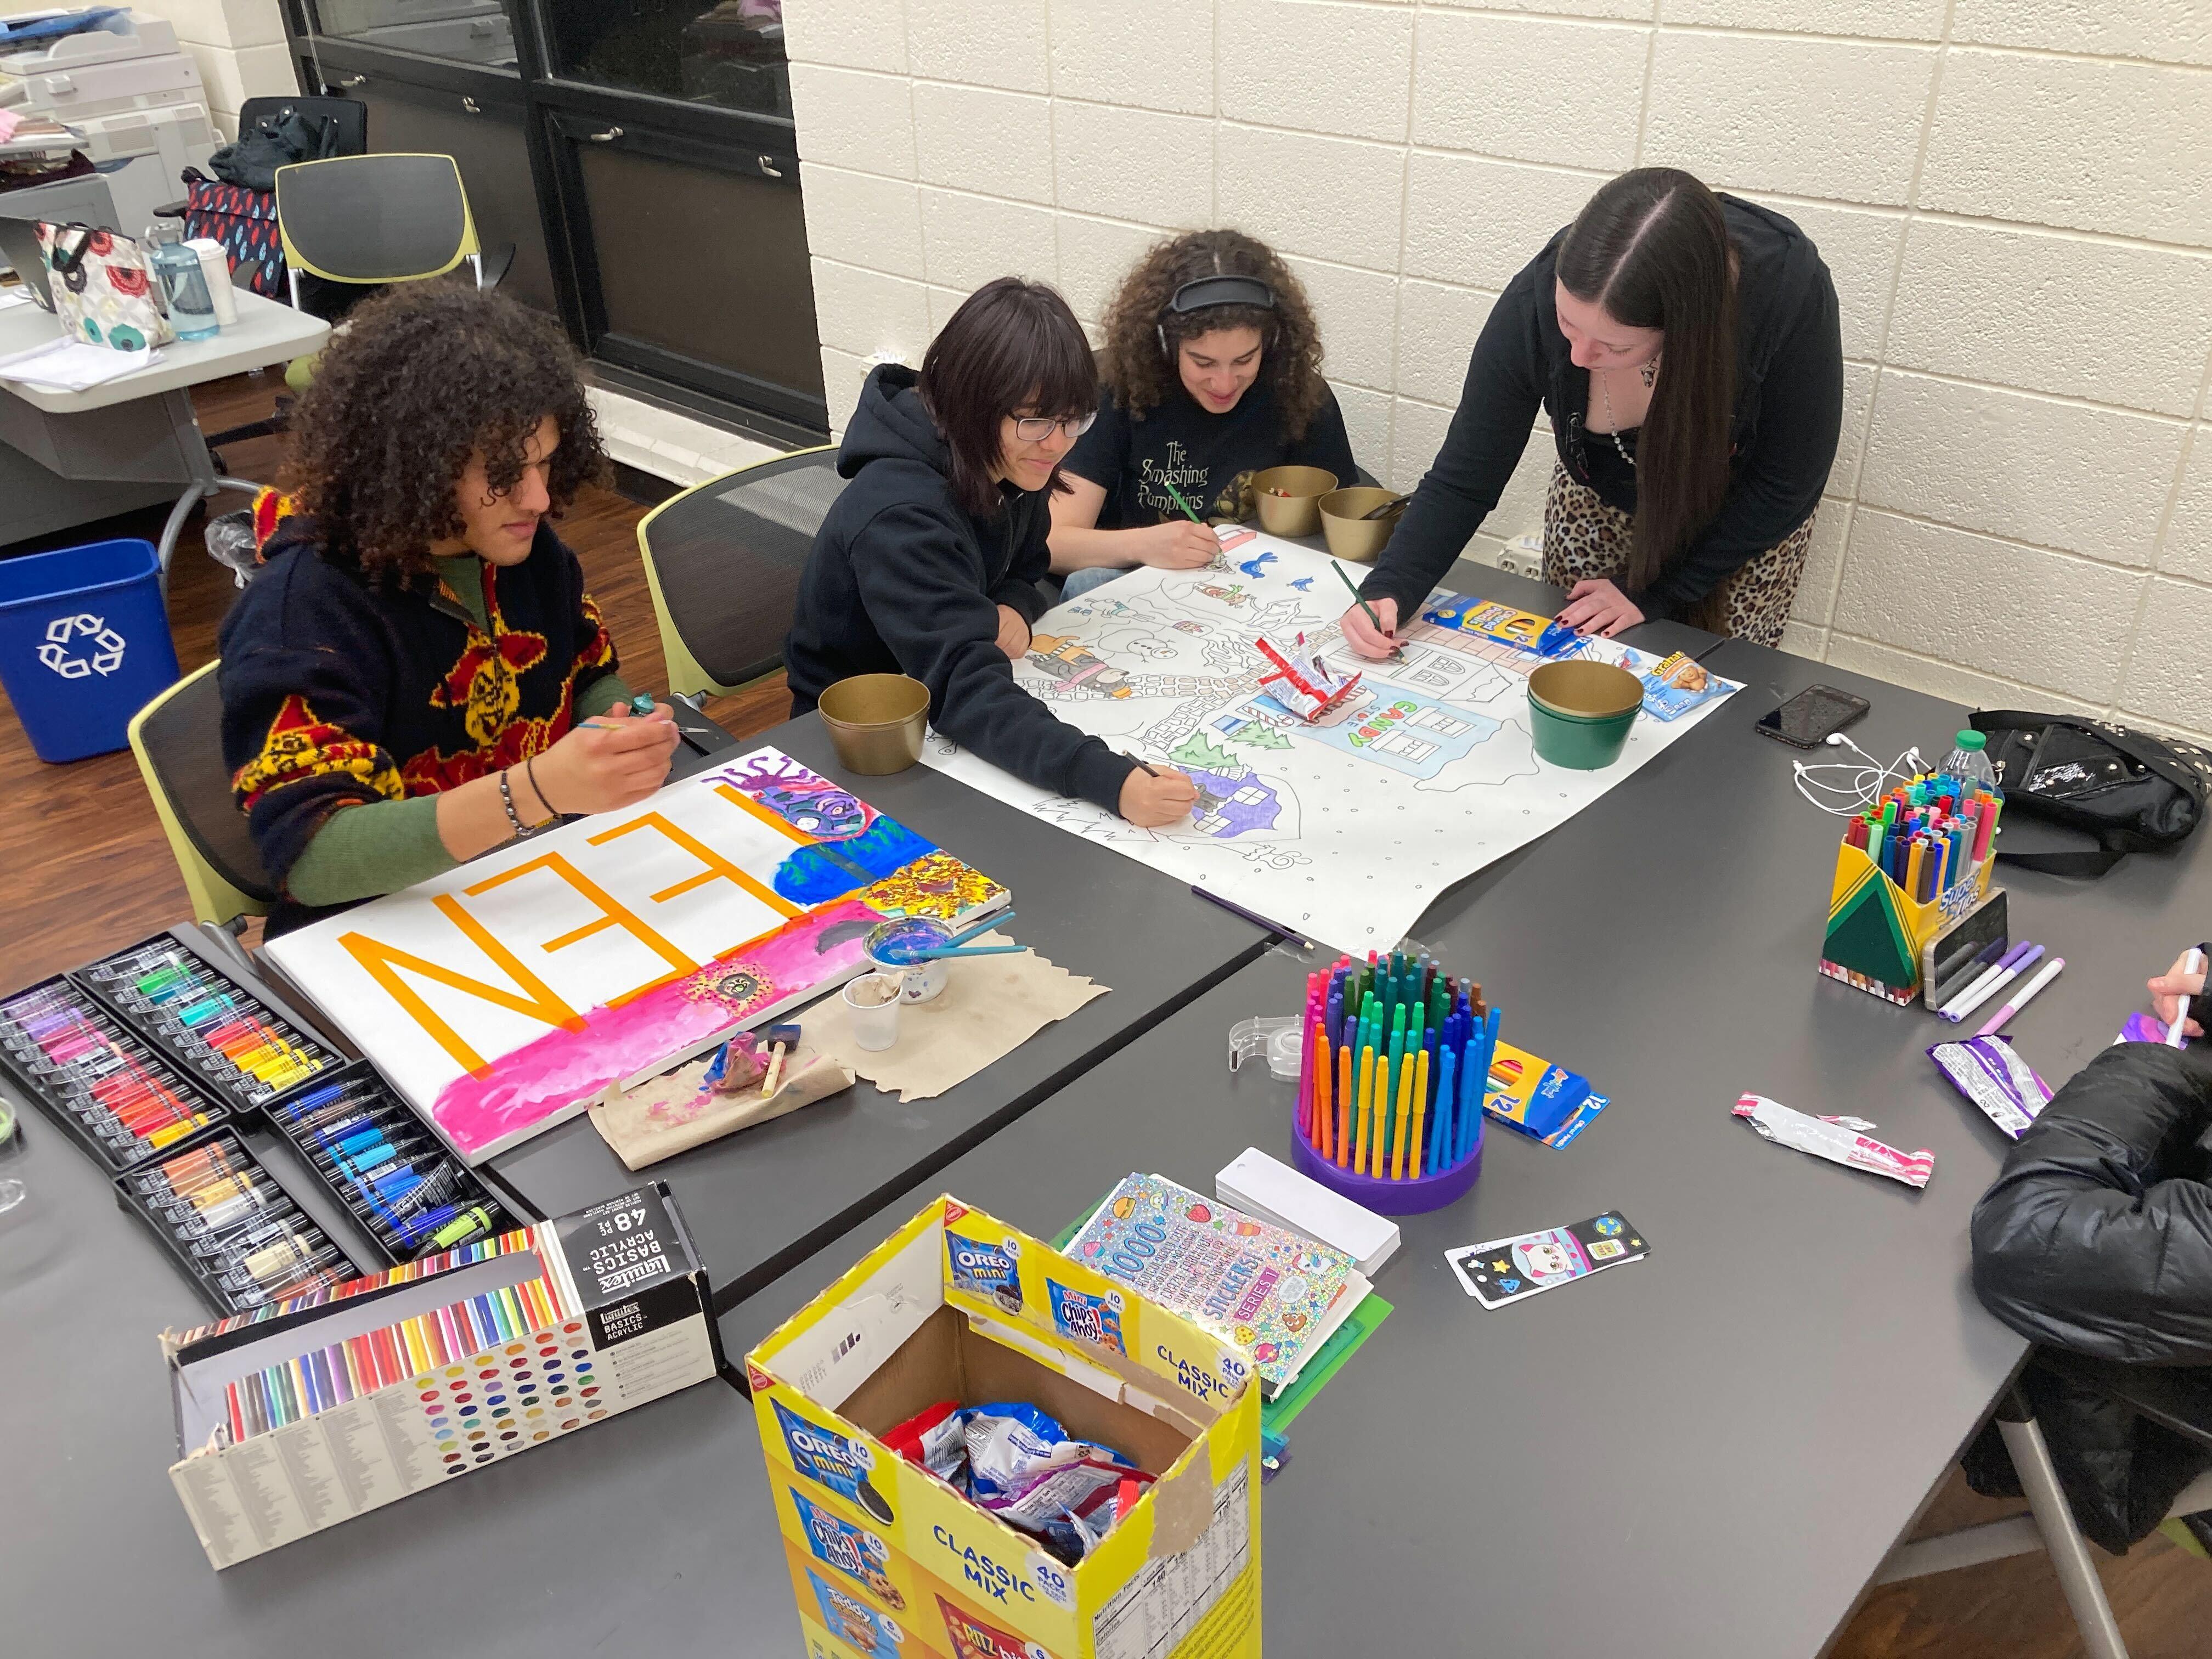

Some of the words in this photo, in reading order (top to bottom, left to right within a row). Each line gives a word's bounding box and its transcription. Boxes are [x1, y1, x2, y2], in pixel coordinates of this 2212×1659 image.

[1166, 441, 1186, 469] The
[1138, 459, 1209, 487] Smashing
[1137, 484, 1204, 514] Pumpins
[1468, 606, 1503, 625] Pencils
[1481, 610, 1518, 631] Colored
[1514, 634, 1533, 642] 12
[1347, 705, 1380, 727] STORE
[1348, 701, 1418, 748] CANDY
[1939, 868, 1981, 912] Super
[1956, 885, 1980, 915] Tips
[1489, 1094, 1521, 1113] 12
[1583, 1095, 1607, 1110] 12
[597, 1220, 610, 1230] PZ
[614, 1209, 646, 1232] 48
[590, 1230, 653, 1261] ACRYLIC
[1007, 1240, 1017, 1250] 10
[593, 1240, 662, 1274] BASICS
[958, 1252, 1010, 1269] OREO
[598, 1255, 671, 1294] Liquitex
[973, 1268, 1006, 1280] mini
[1203, 1251, 1263, 1320] STICKERS!
[1063, 1290, 1087, 1305] Mini
[1110, 1293, 1121, 1304] 10
[1238, 1278, 1272, 1319] SERIES
[600, 1302, 640, 1324] Liquitex
[604, 1314, 642, 1334] BASICS
[1063, 1302, 1094, 1324] Chips
[607, 1322, 643, 1340] ACRYLIC
[1157, 1345, 1228, 1398] CLASSIC
[1223, 1358, 1245, 1376] 40
[1178, 1372, 1208, 1402] MIX
[792, 1431, 856, 1467] OREO
[855, 1442, 868, 1459] 10
[812, 1454, 854, 1479] mini
[809, 1505, 839, 1531] Mini
[812, 1519, 850, 1551] Chips
[870, 1536, 882, 1551] 10
[933, 1525, 1036, 1602] CLASSIC
[964, 1564, 1008, 1605] MIX
[1037, 1566, 1064, 1589] 40
[1037, 1576, 1066, 1598] PACKS
[1152, 1571, 1166, 1588] 140
[825, 1587, 872, 1622] Teddy
[1094, 1593, 1122, 1621] Nutrition
[1123, 1573, 1141, 1592] Facts
[964, 1622, 998, 1656] RITZ
